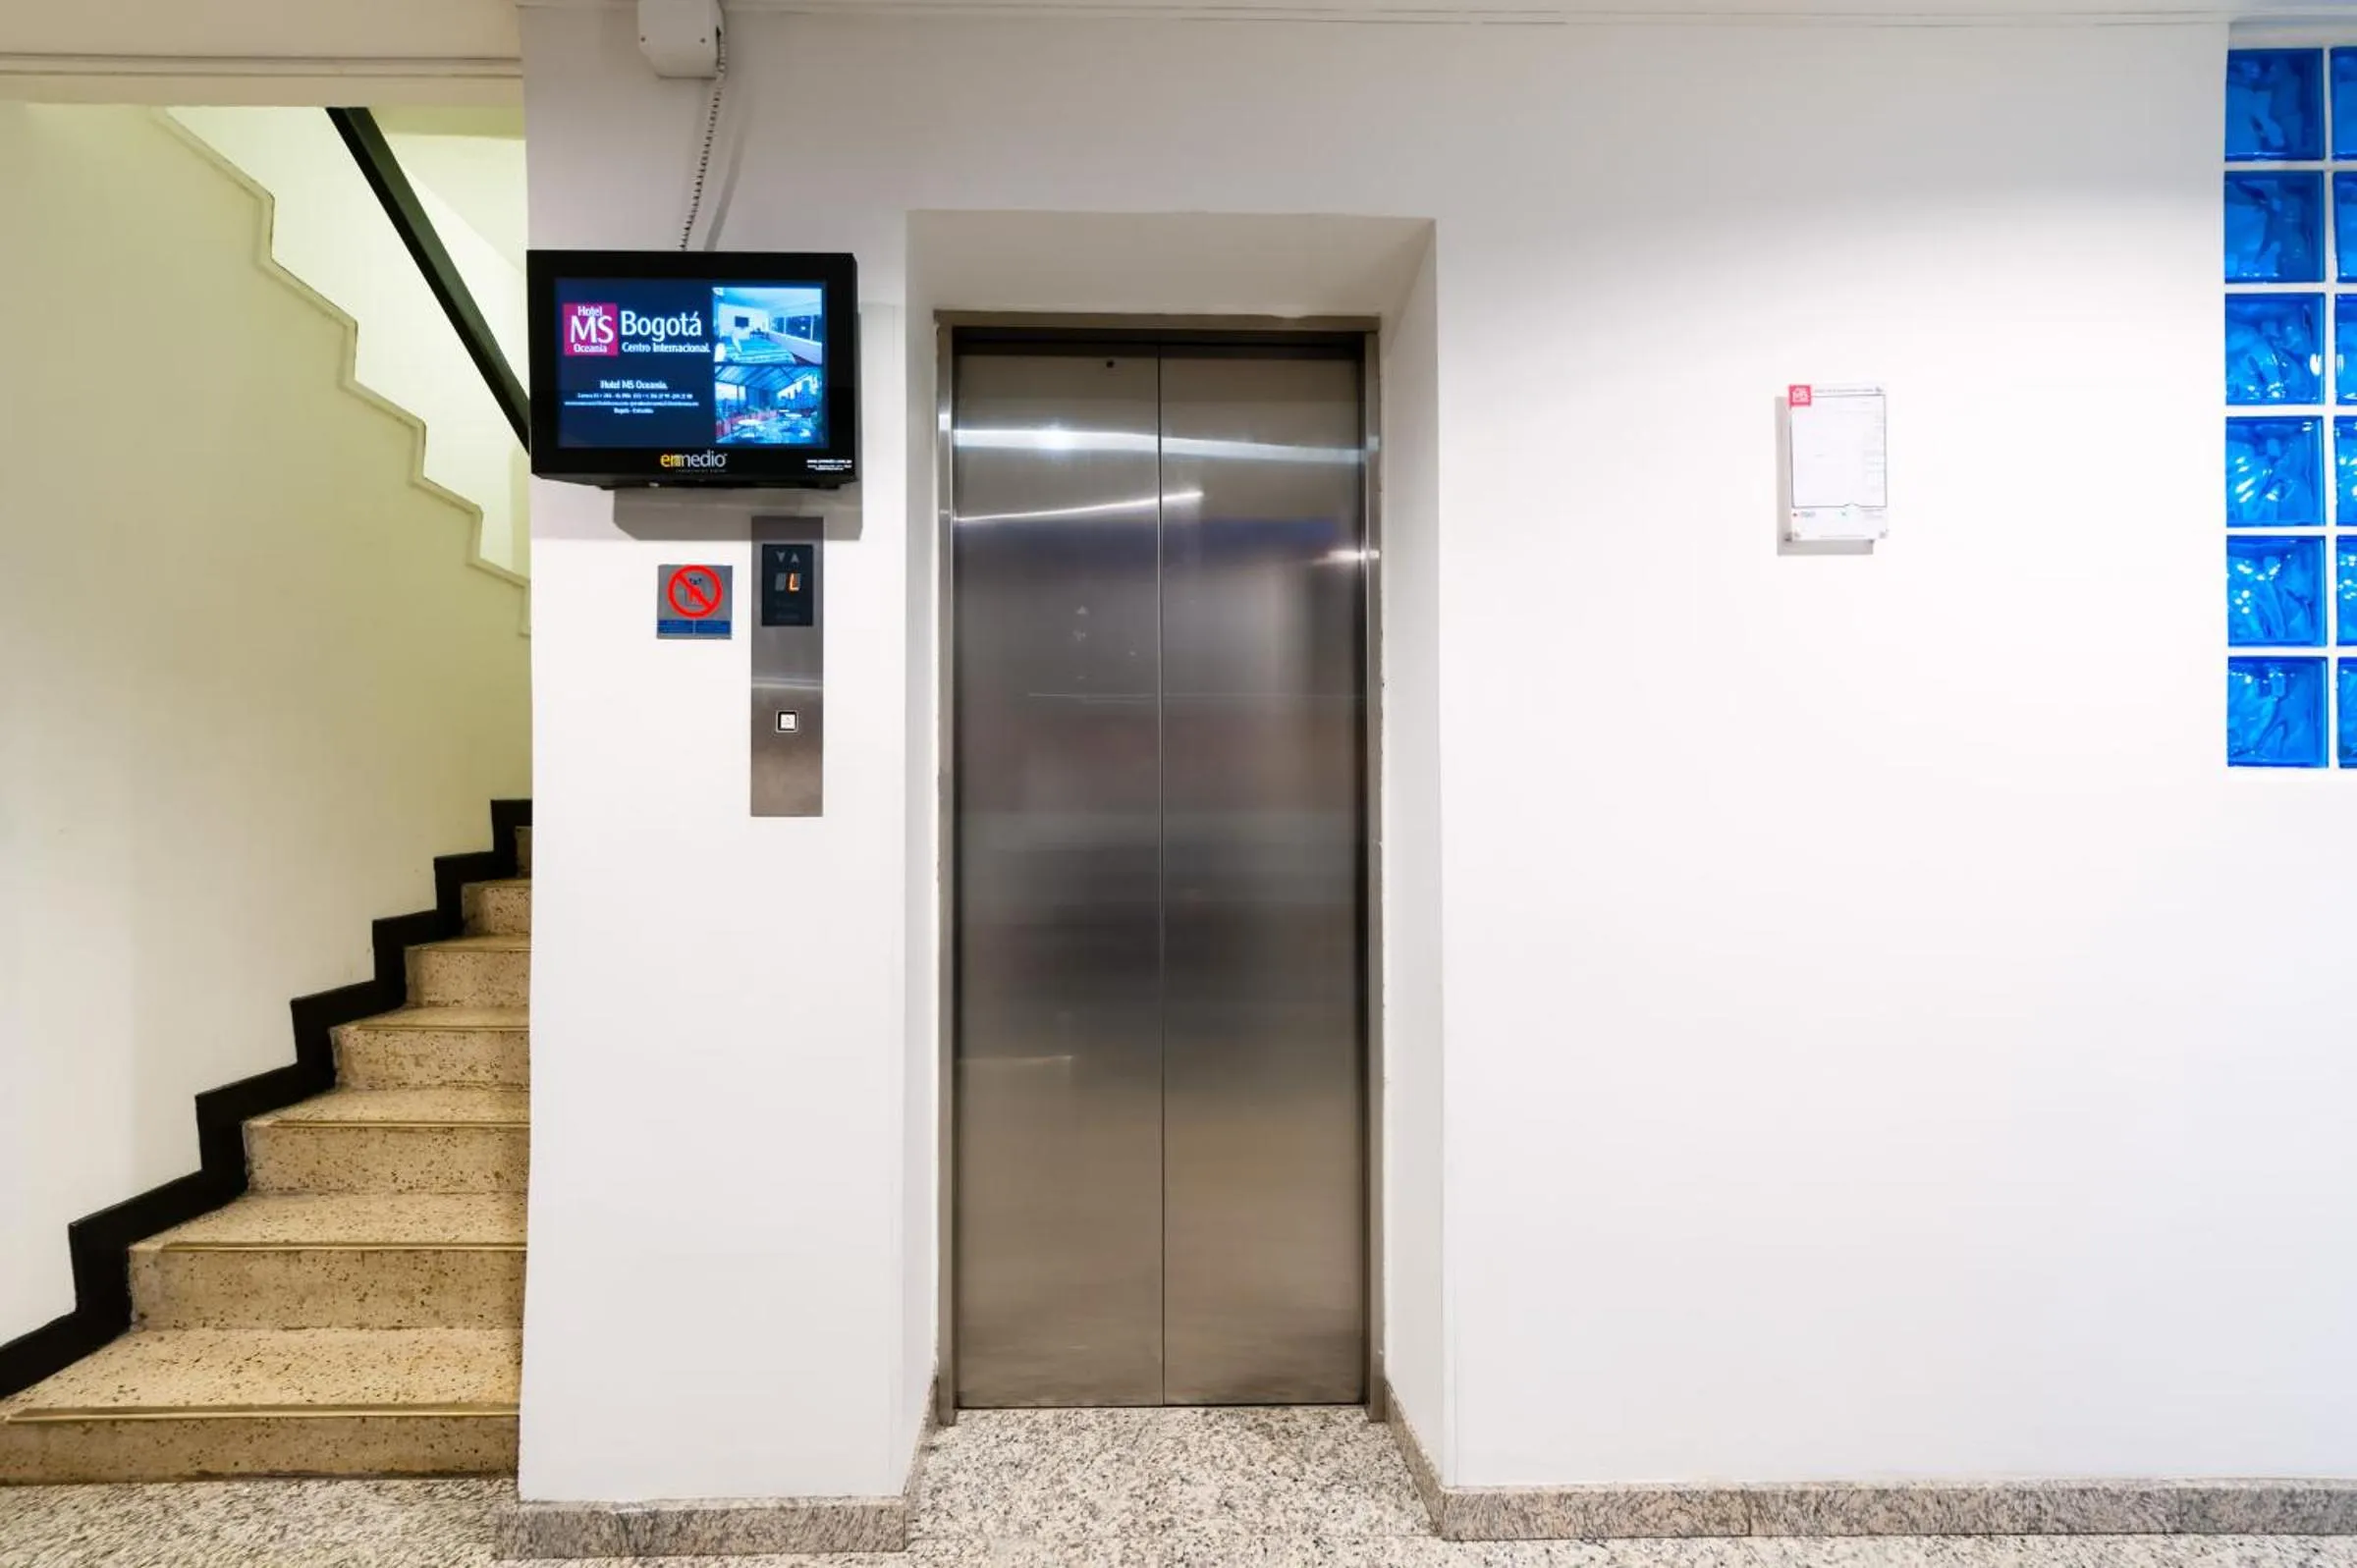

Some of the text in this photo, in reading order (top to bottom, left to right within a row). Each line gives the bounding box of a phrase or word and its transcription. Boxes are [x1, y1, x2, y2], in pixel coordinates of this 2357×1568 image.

[577, 305, 603, 316] Hotel
[570, 314, 614, 344] MS
[621, 310, 702, 343] Bogotá
[622, 342, 651, 352] Centro
[600, 380, 621, 389] Hotel
[622, 380, 634, 389] MS
